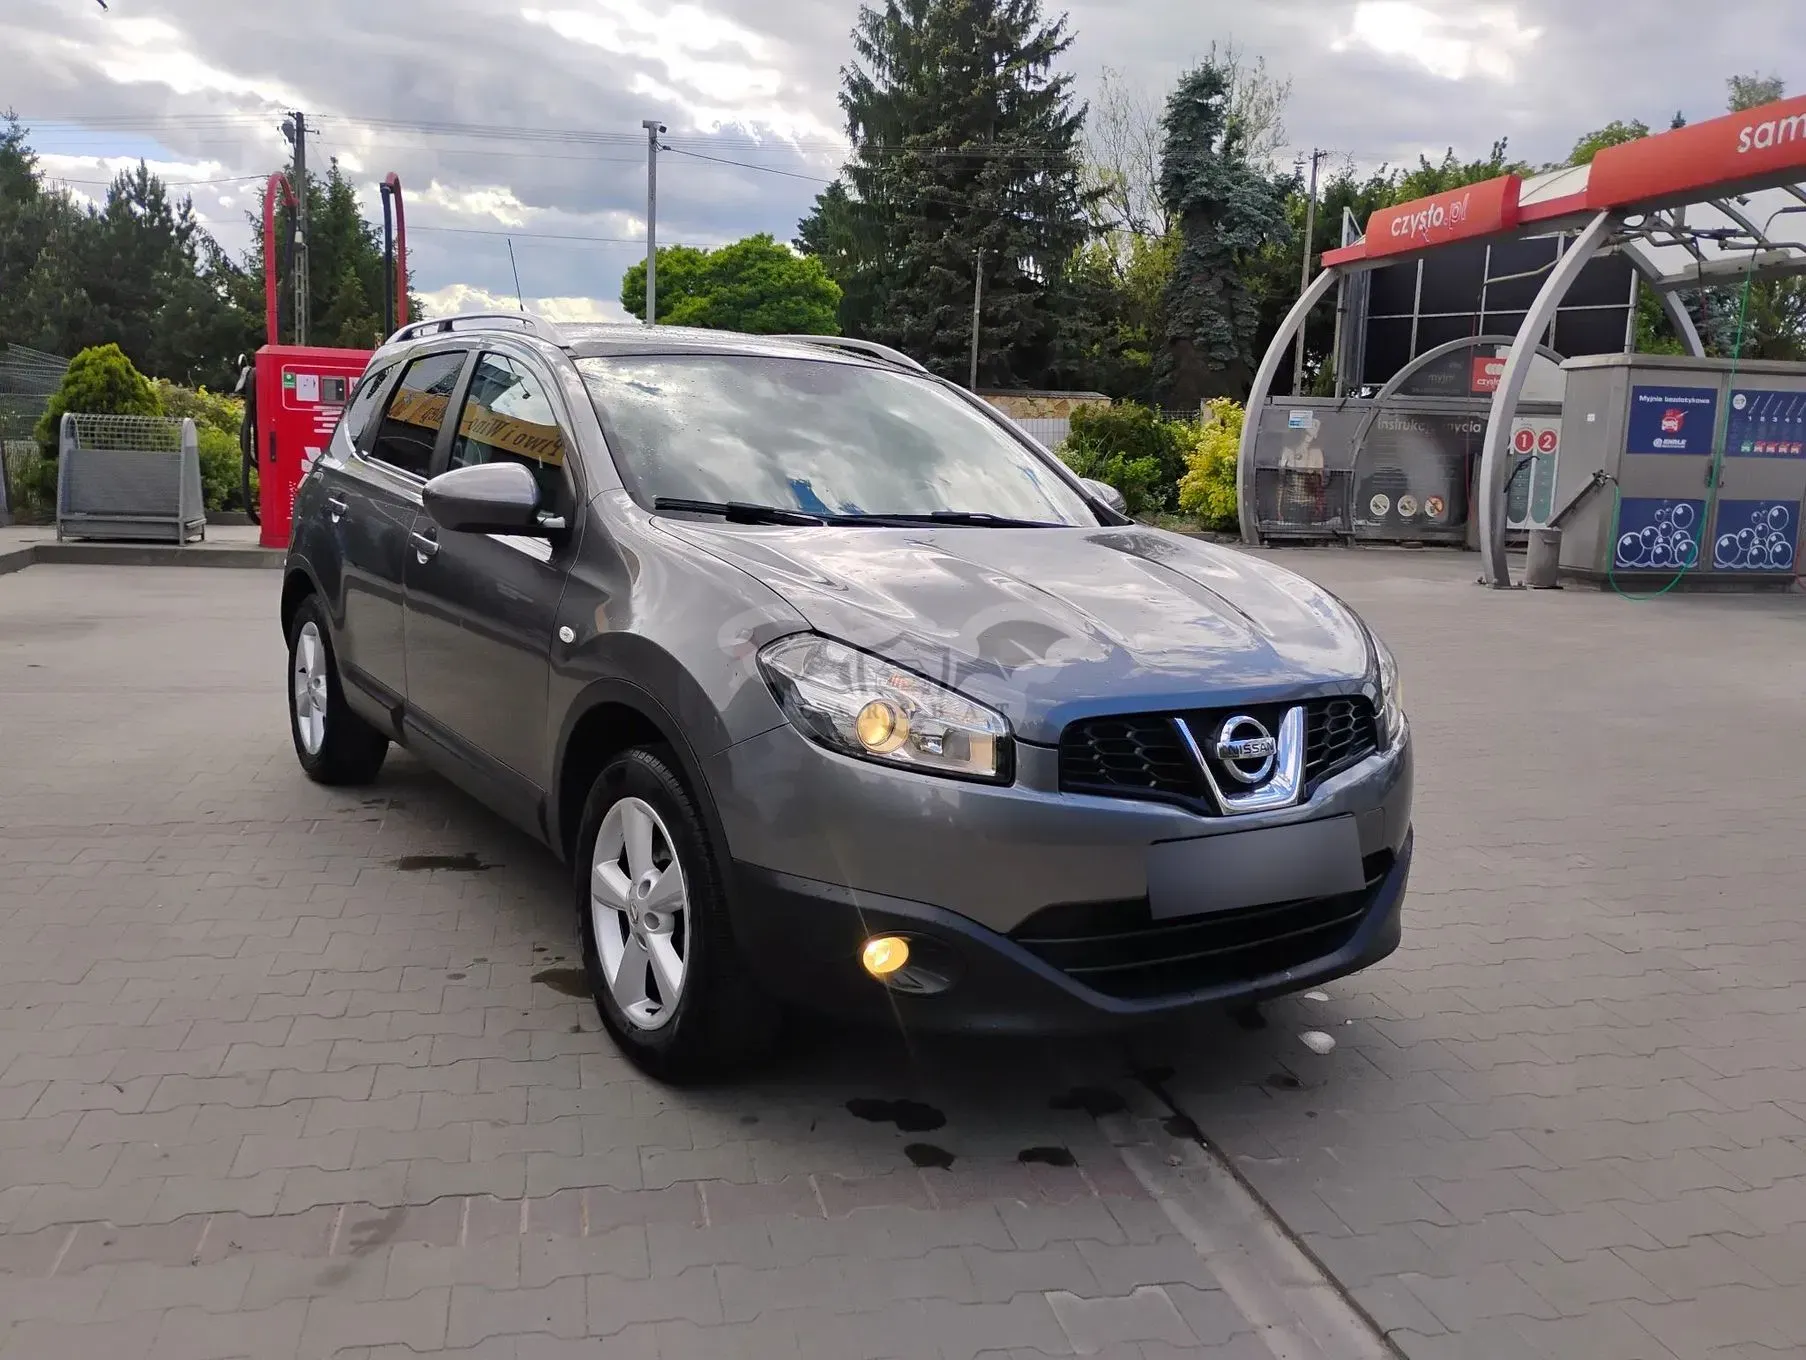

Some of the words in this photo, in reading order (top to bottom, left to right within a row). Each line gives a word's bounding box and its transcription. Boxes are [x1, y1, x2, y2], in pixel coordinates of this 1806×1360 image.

[1521, 433, 1528, 448] 1
[1542, 434, 1552, 449] 2
[1227, 740, 1275, 757] NISSAN
